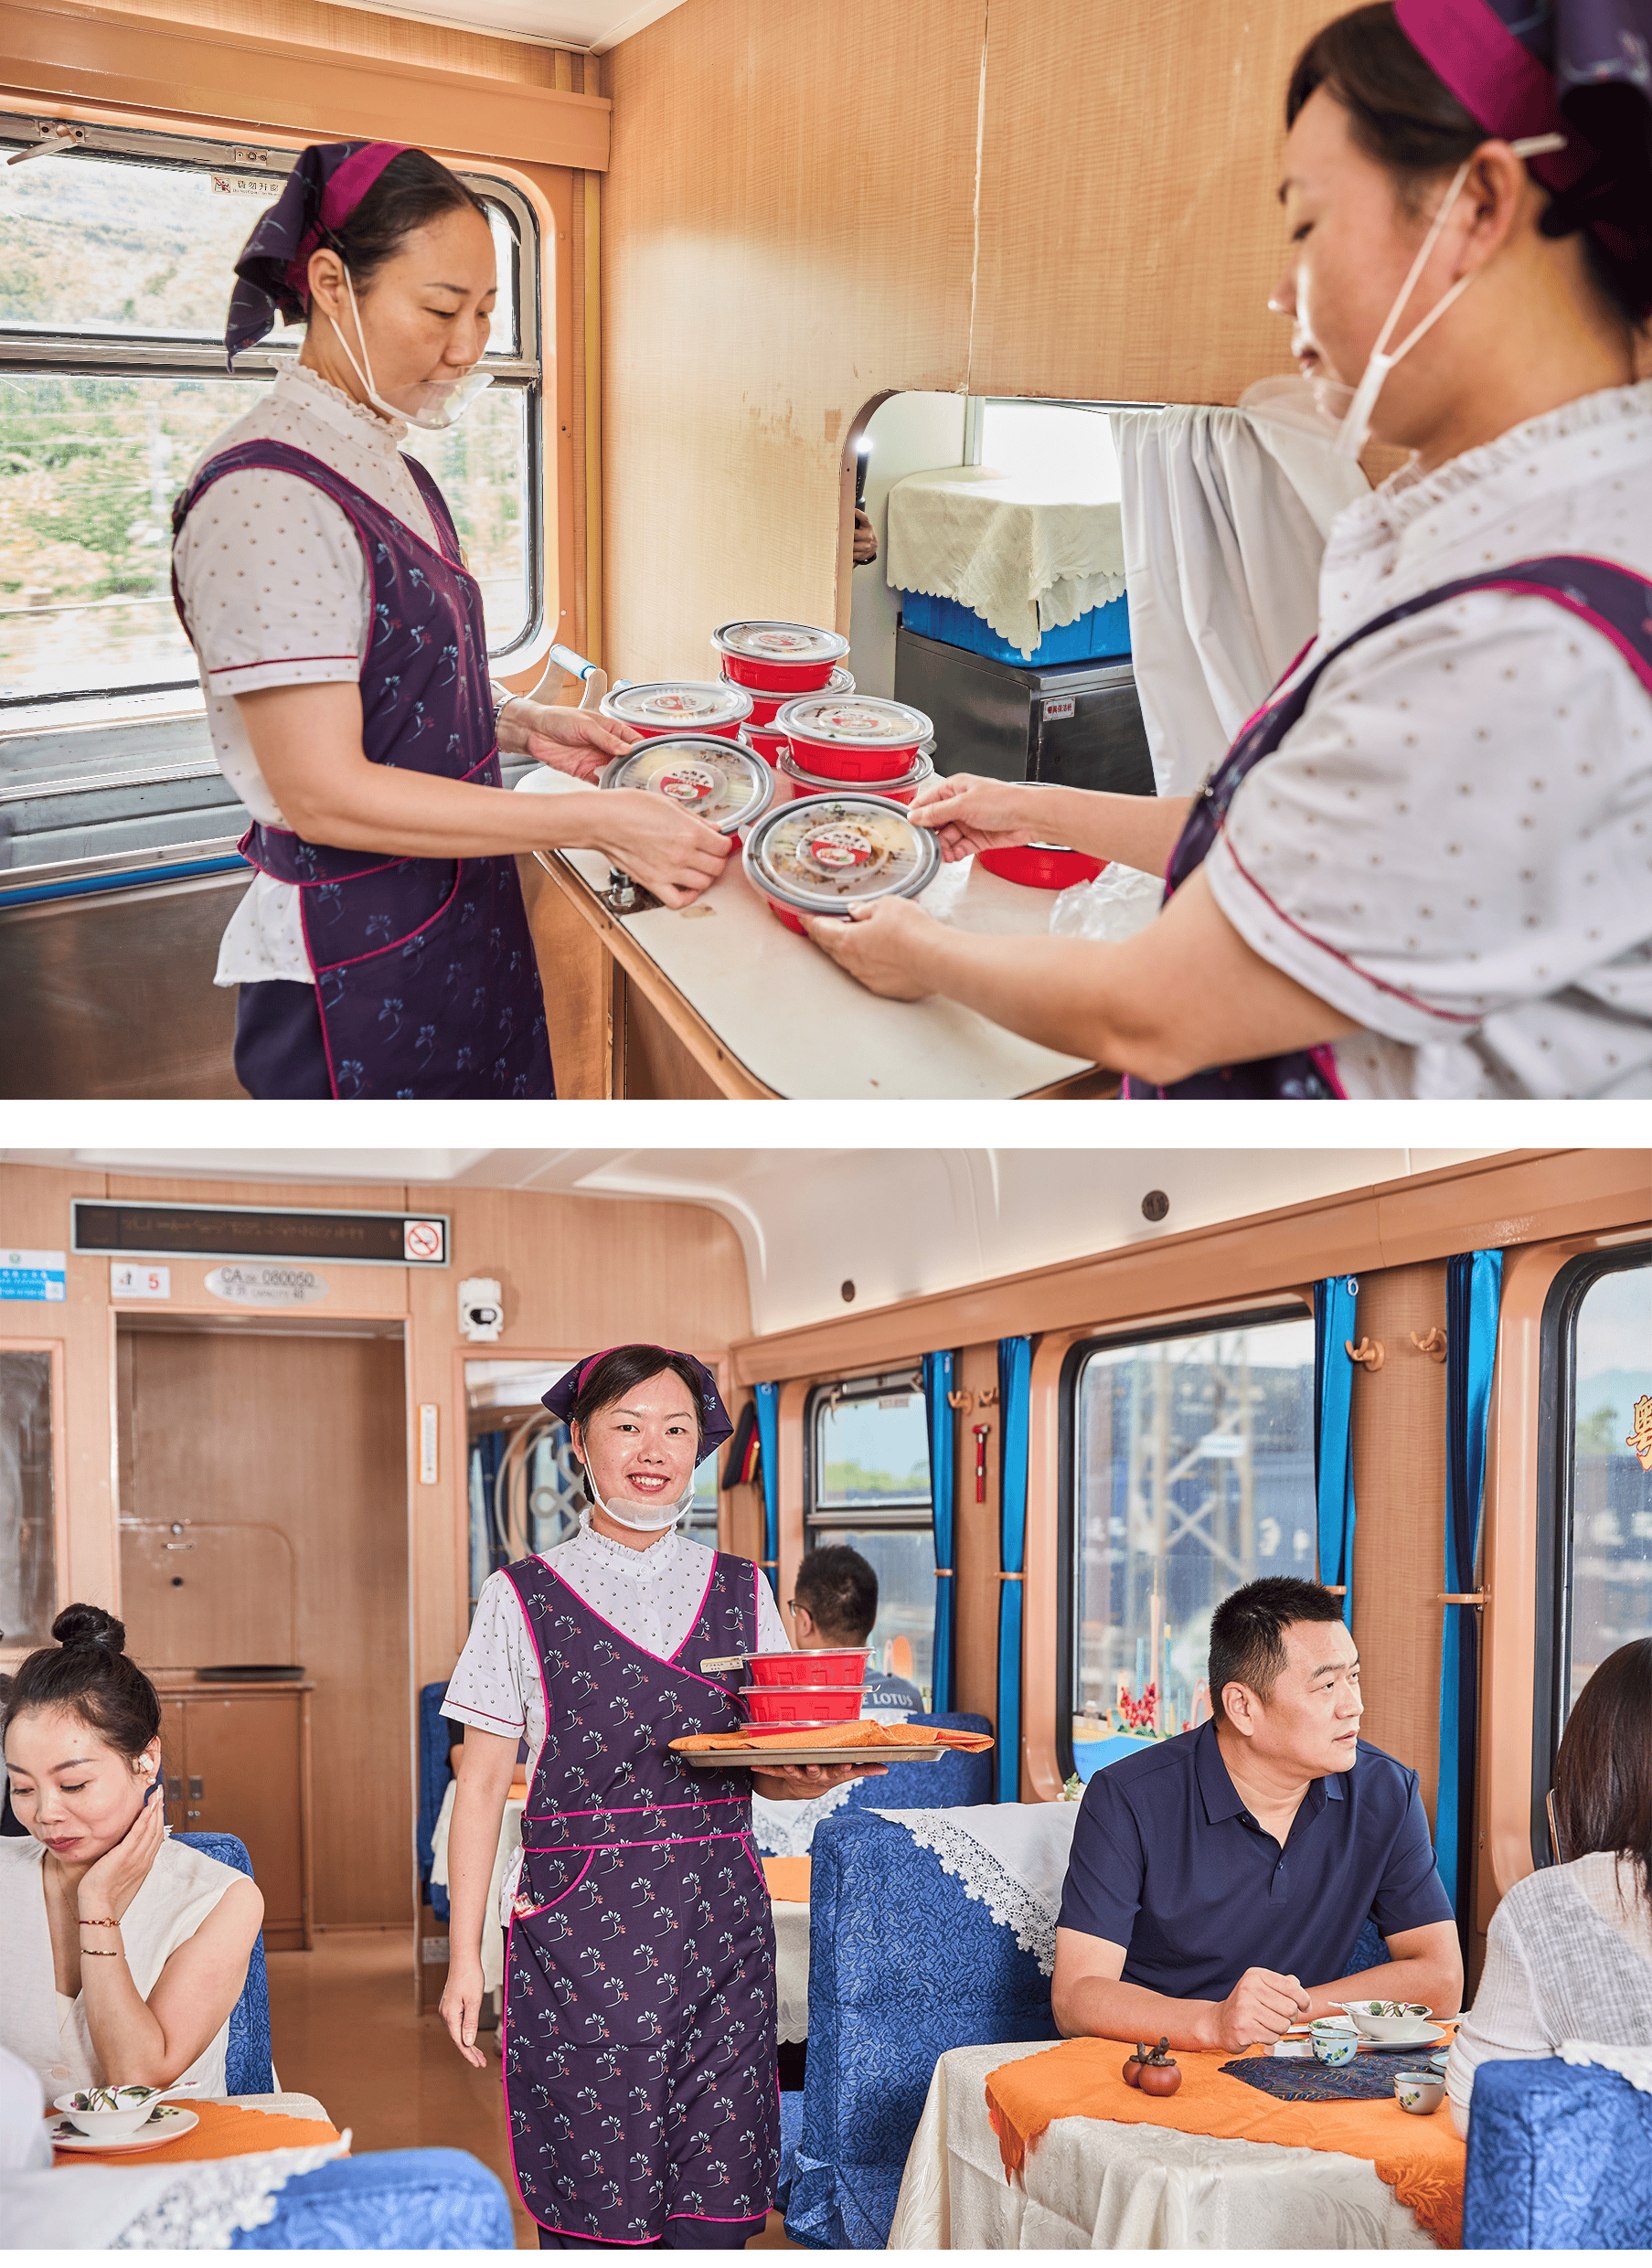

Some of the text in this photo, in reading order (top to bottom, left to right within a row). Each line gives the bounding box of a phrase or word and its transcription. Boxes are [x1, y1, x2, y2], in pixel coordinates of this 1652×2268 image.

[238, 180, 279, 192] 请勿开窗
[148, 1272, 160, 1291] 5
[872, 1692, 913, 1708] LOTUS
